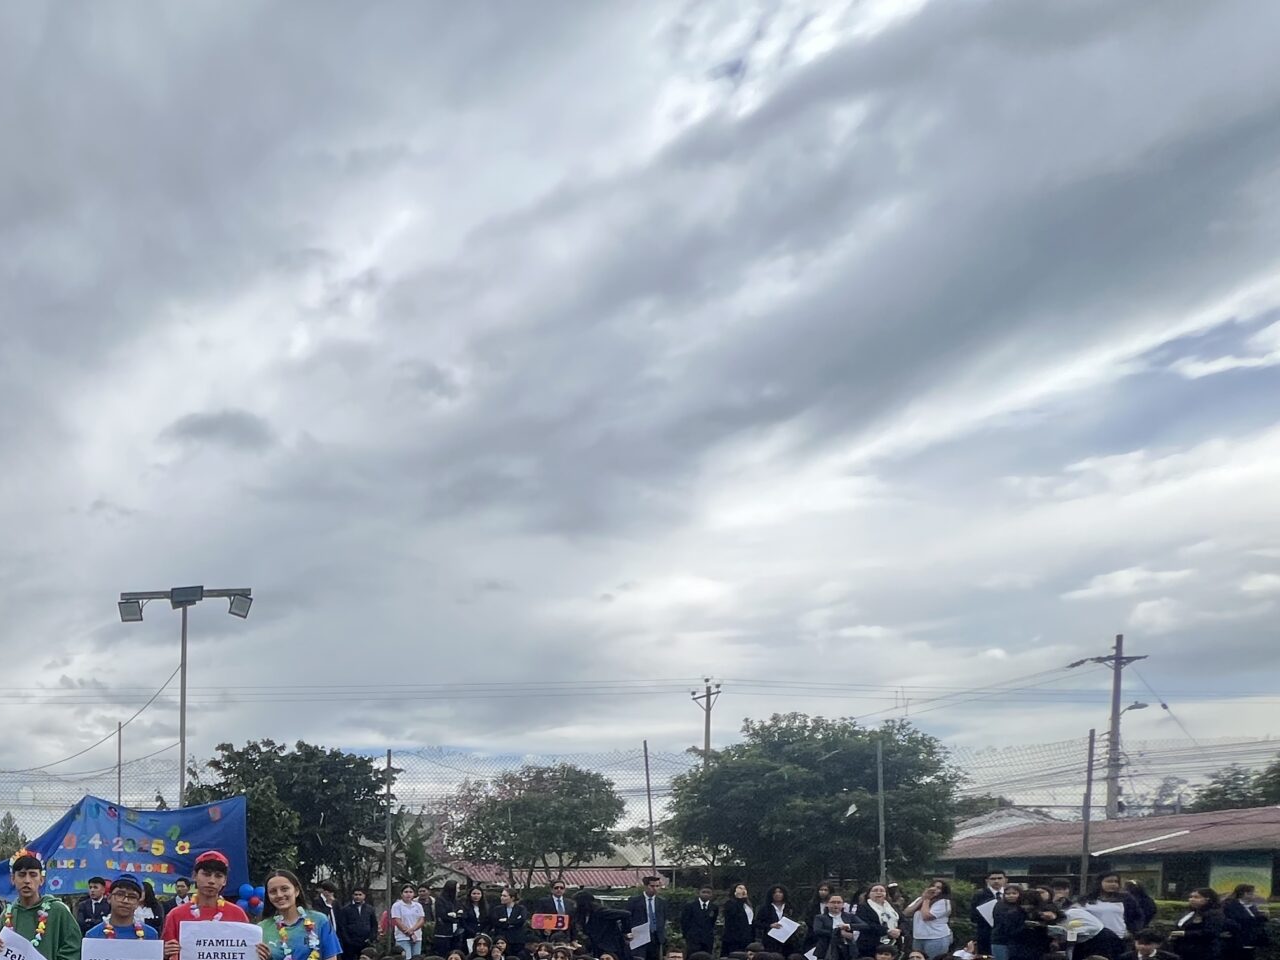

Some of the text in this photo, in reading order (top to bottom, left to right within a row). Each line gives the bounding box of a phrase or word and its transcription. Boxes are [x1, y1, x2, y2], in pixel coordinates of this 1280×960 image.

[59, 831, 165, 857] 024-2025
[195, 938, 247, 947] #FAMILIA
[197, 951, 246, 960] HARRIET
